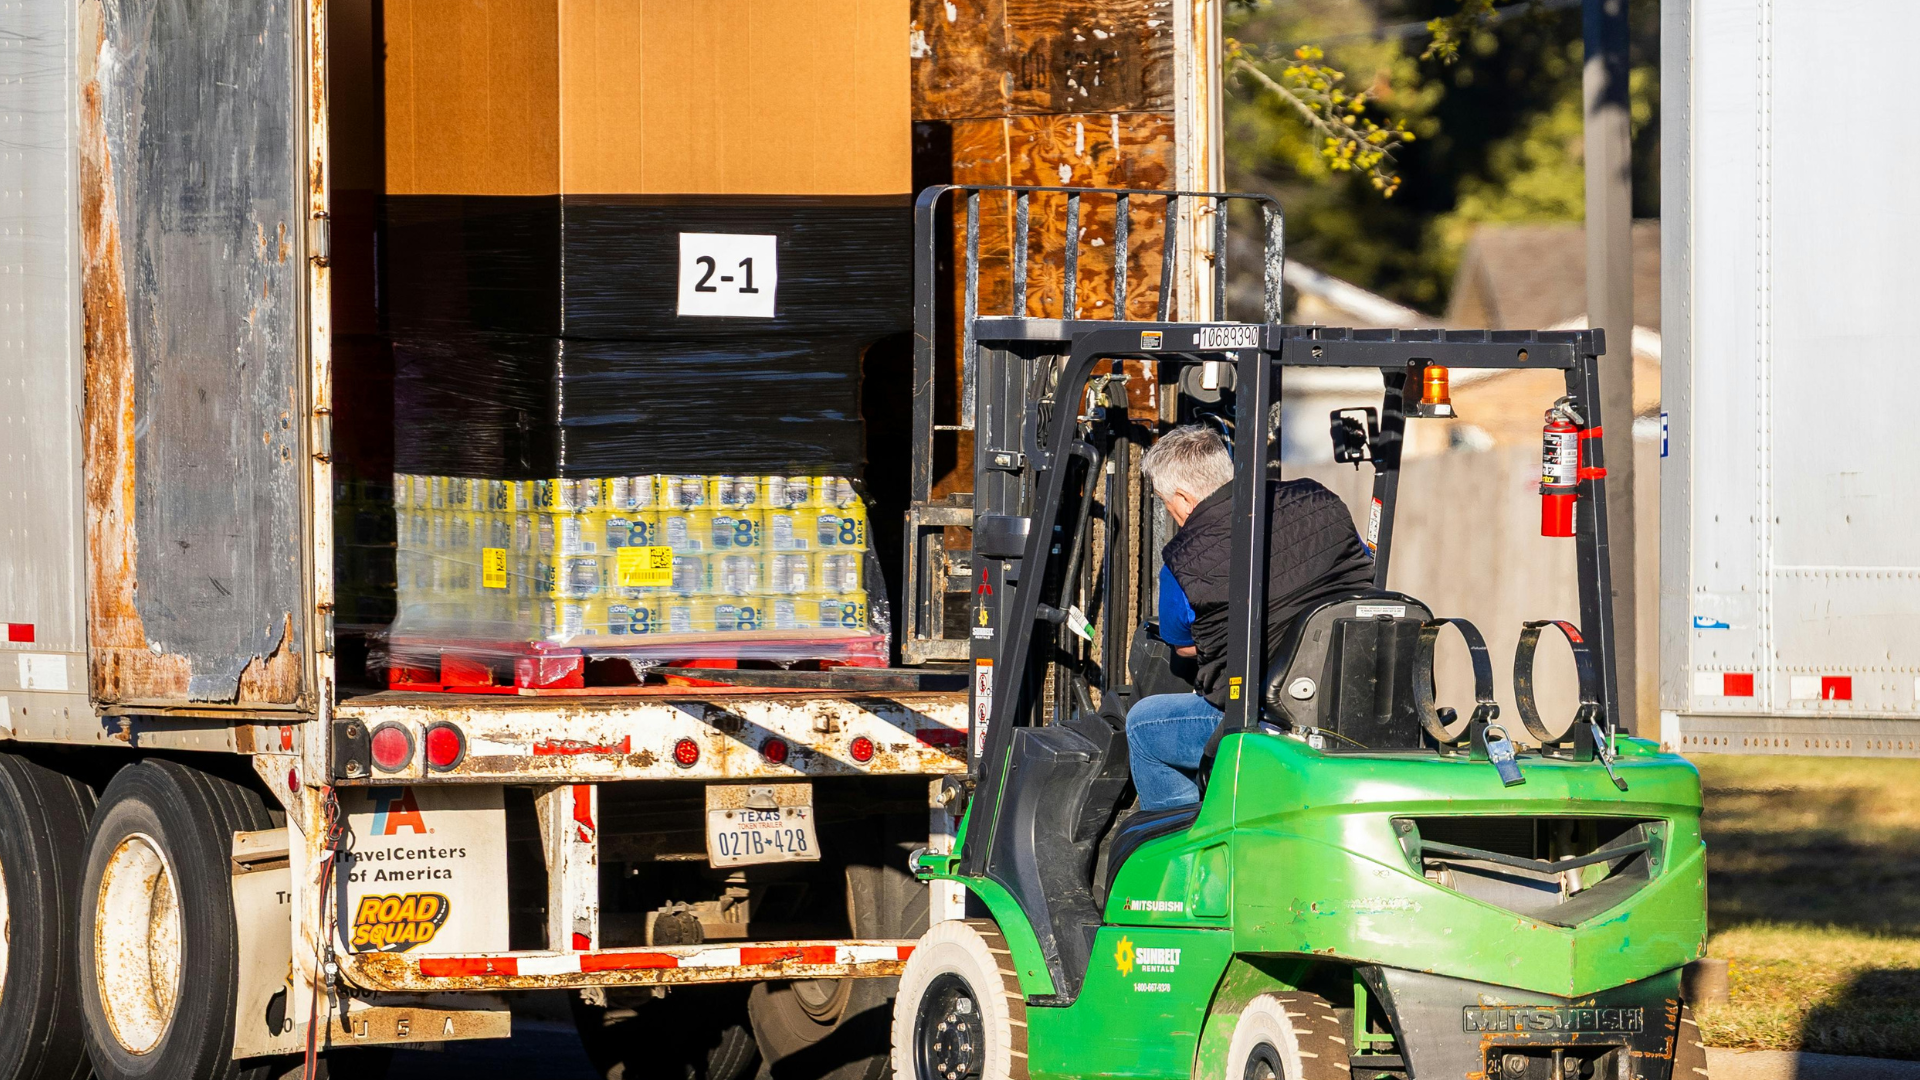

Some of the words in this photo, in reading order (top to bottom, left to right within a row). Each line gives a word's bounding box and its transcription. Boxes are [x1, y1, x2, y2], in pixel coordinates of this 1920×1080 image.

[695, 255, 759, 294] 2-1
[1202, 327, 1258, 346] 10689390
[733, 519, 753, 547] 8
[838, 518, 857, 545] 8
[629, 607, 650, 634] 8
[736, 606, 757, 631] 8
[841, 601, 858, 629] 8
[367, 786, 427, 836] TA
[739, 811, 781, 822] TEXAS
[759, 821, 783, 829] TRAILER
[335, 847, 467, 863] TravelCenters
[349, 870, 367, 883] of
[374, 867, 453, 882] America
[357, 896, 440, 924] ROAD
[1131, 900, 1183, 912] MITSUBISHI
[353, 920, 436, 949] SQUAD
[1135, 947, 1182, 966] SUNBELT
[1141, 965, 1175, 973] RENTALS
